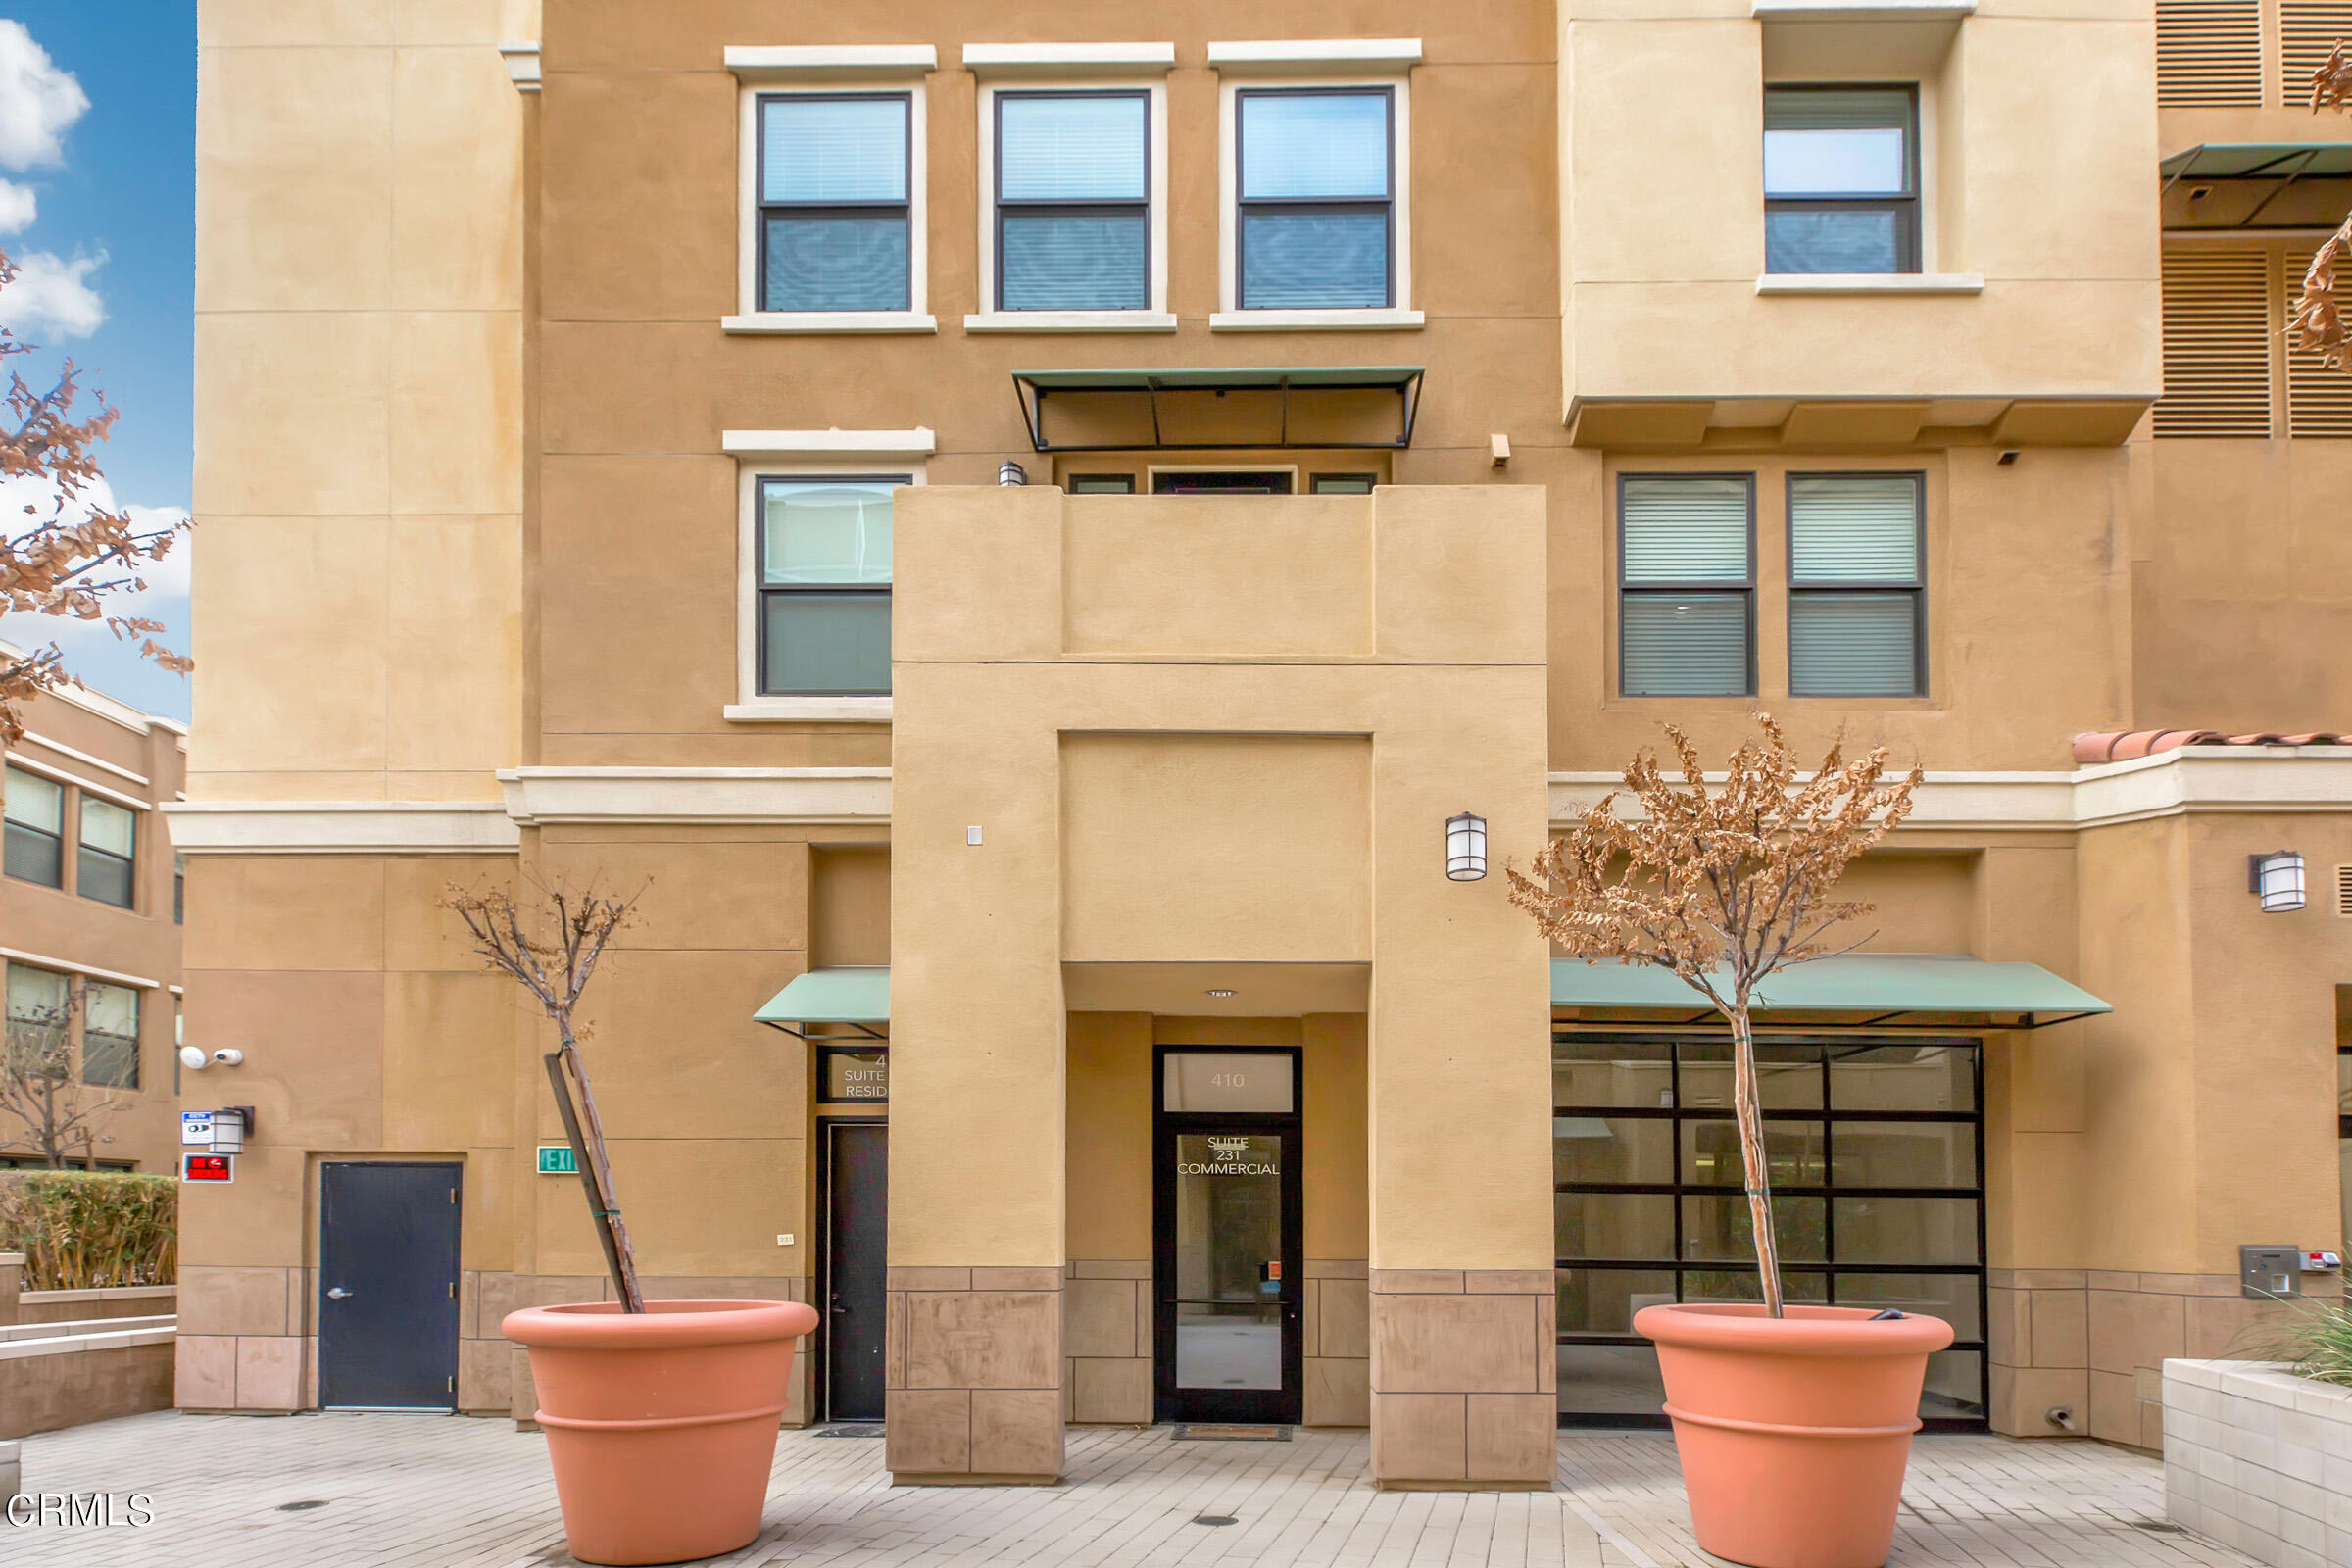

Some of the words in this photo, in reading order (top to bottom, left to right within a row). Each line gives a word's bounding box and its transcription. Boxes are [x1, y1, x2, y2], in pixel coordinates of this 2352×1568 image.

[875, 1054, 887, 1068] 4
[845, 1070, 886, 1081] SUITE
[1211, 1073, 1245, 1088] 410
[846, 1085, 887, 1097] RESID
[1207, 1137, 1250, 1149] SUITE
[546, 1150, 578, 1171] EXI
[1216, 1151, 1240, 1161] 231
[1177, 1163, 1281, 1175] COMMERCIAL
